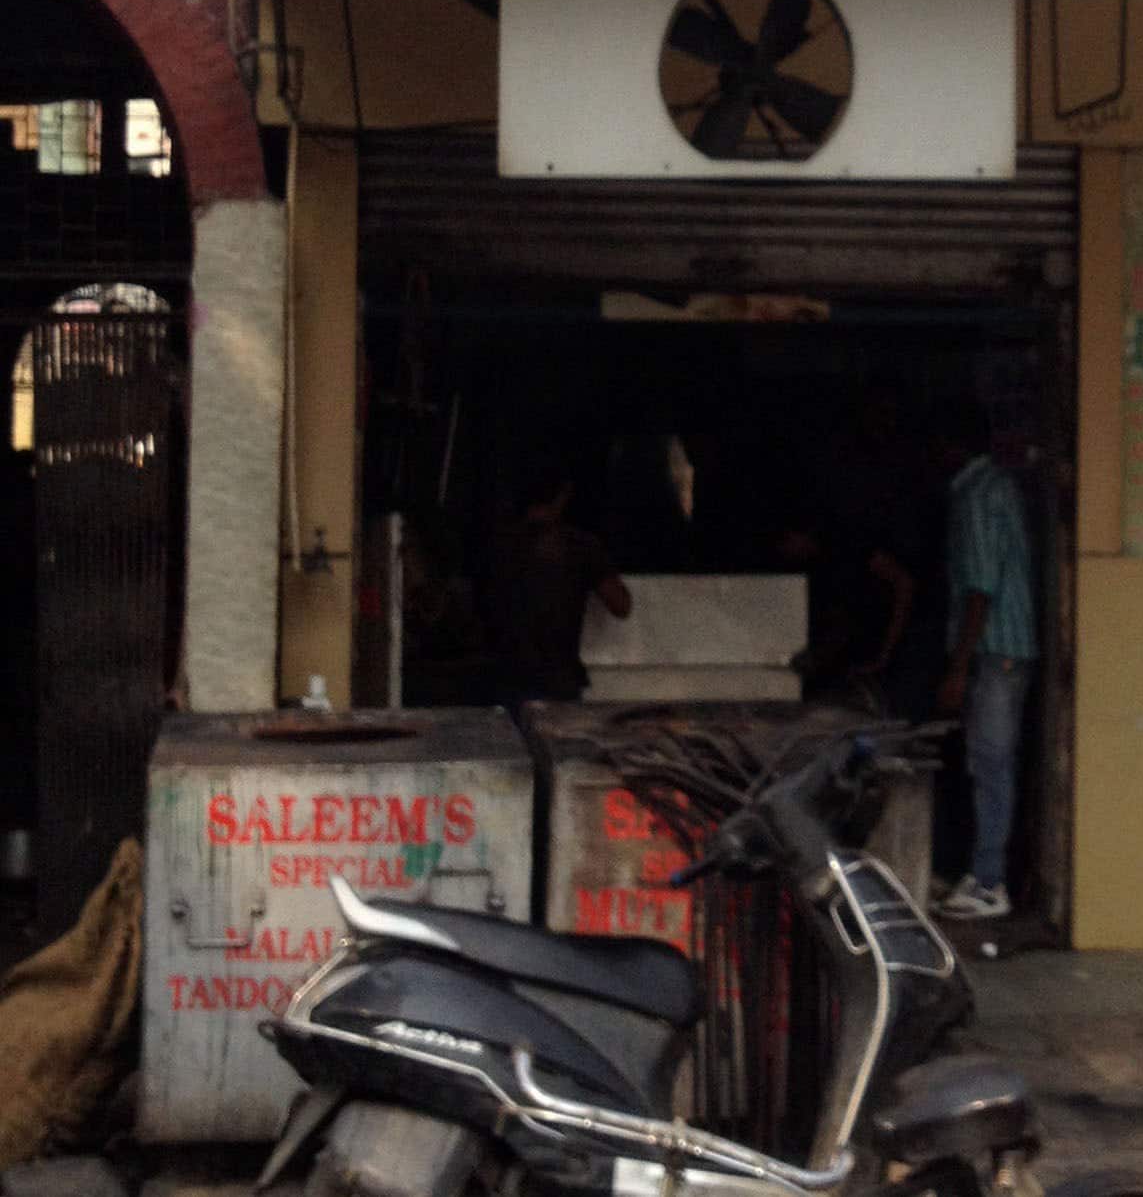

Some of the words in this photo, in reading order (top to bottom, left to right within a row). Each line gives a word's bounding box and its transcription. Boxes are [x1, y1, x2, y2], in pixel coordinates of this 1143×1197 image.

[206, 792, 476, 847] SALEEM'S
[270, 854, 414, 889] SPECIAL
[168, 974, 304, 1011] TANDO
